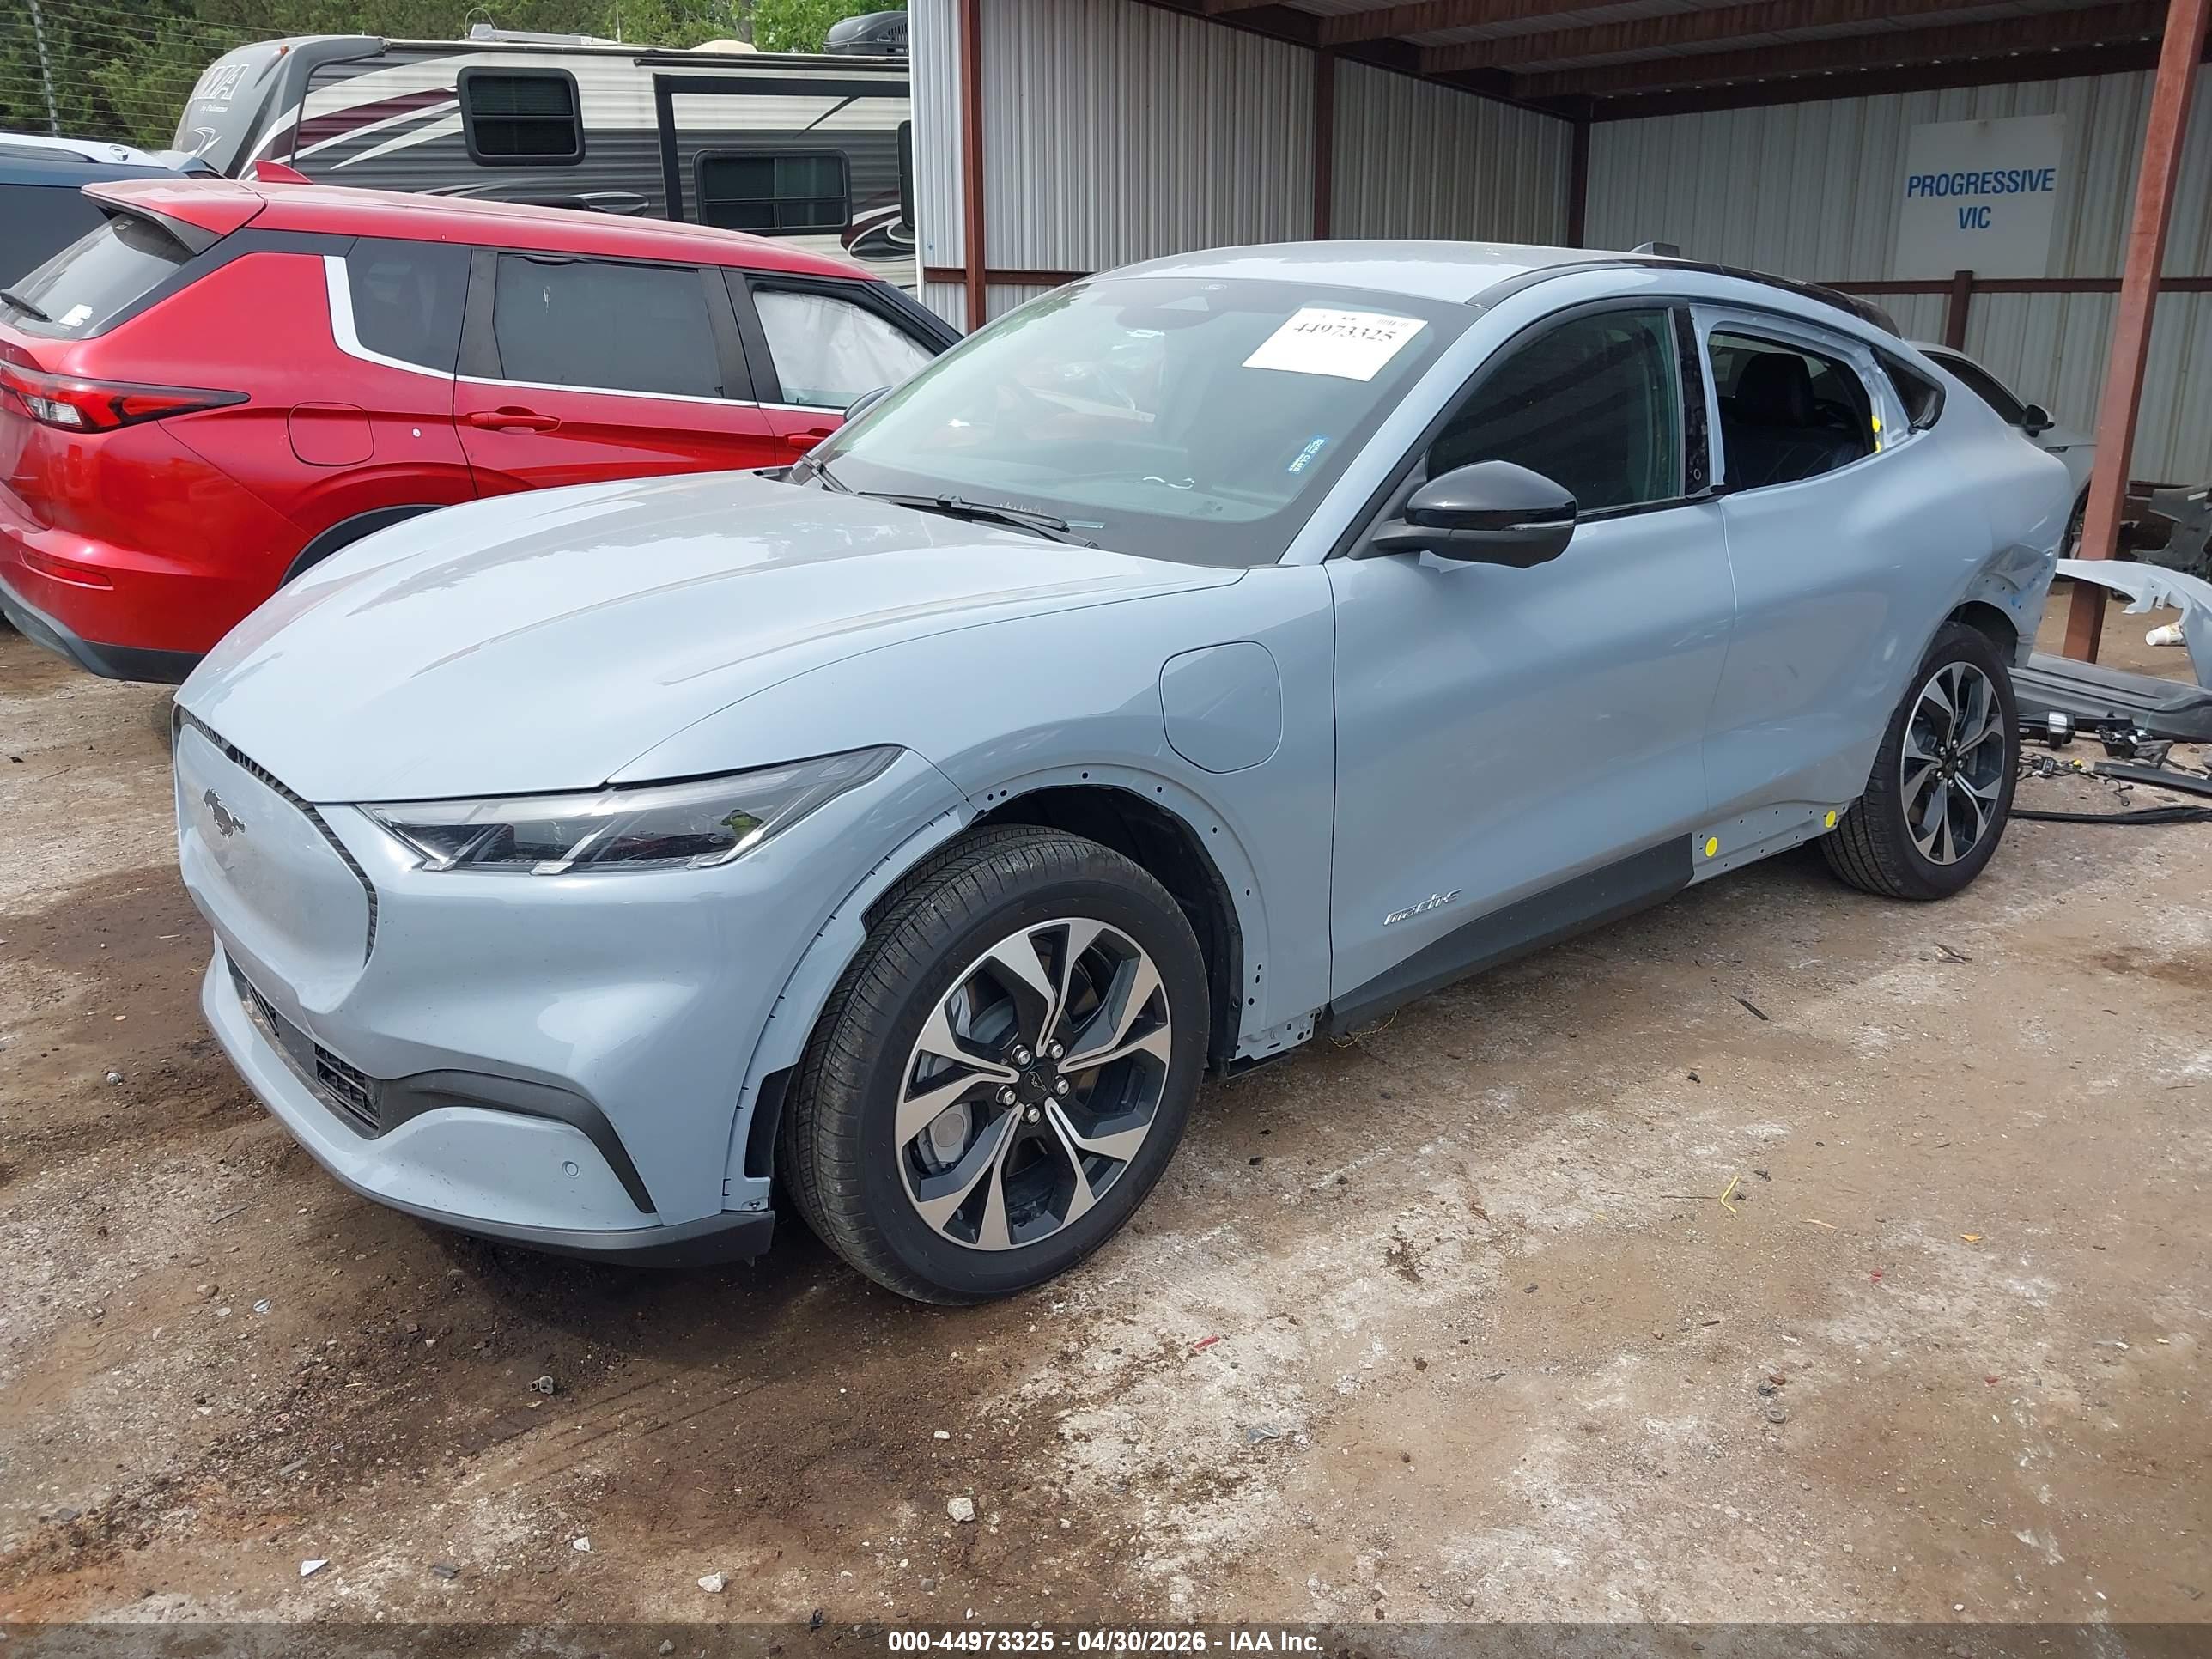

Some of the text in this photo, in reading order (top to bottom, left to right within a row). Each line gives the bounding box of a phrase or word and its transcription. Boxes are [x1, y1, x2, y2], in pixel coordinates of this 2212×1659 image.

[1907, 167, 2057, 198] PROGRESSIVE
[1958, 205, 1992, 229] VIC
[1294, 322, 1397, 342] 44973325
